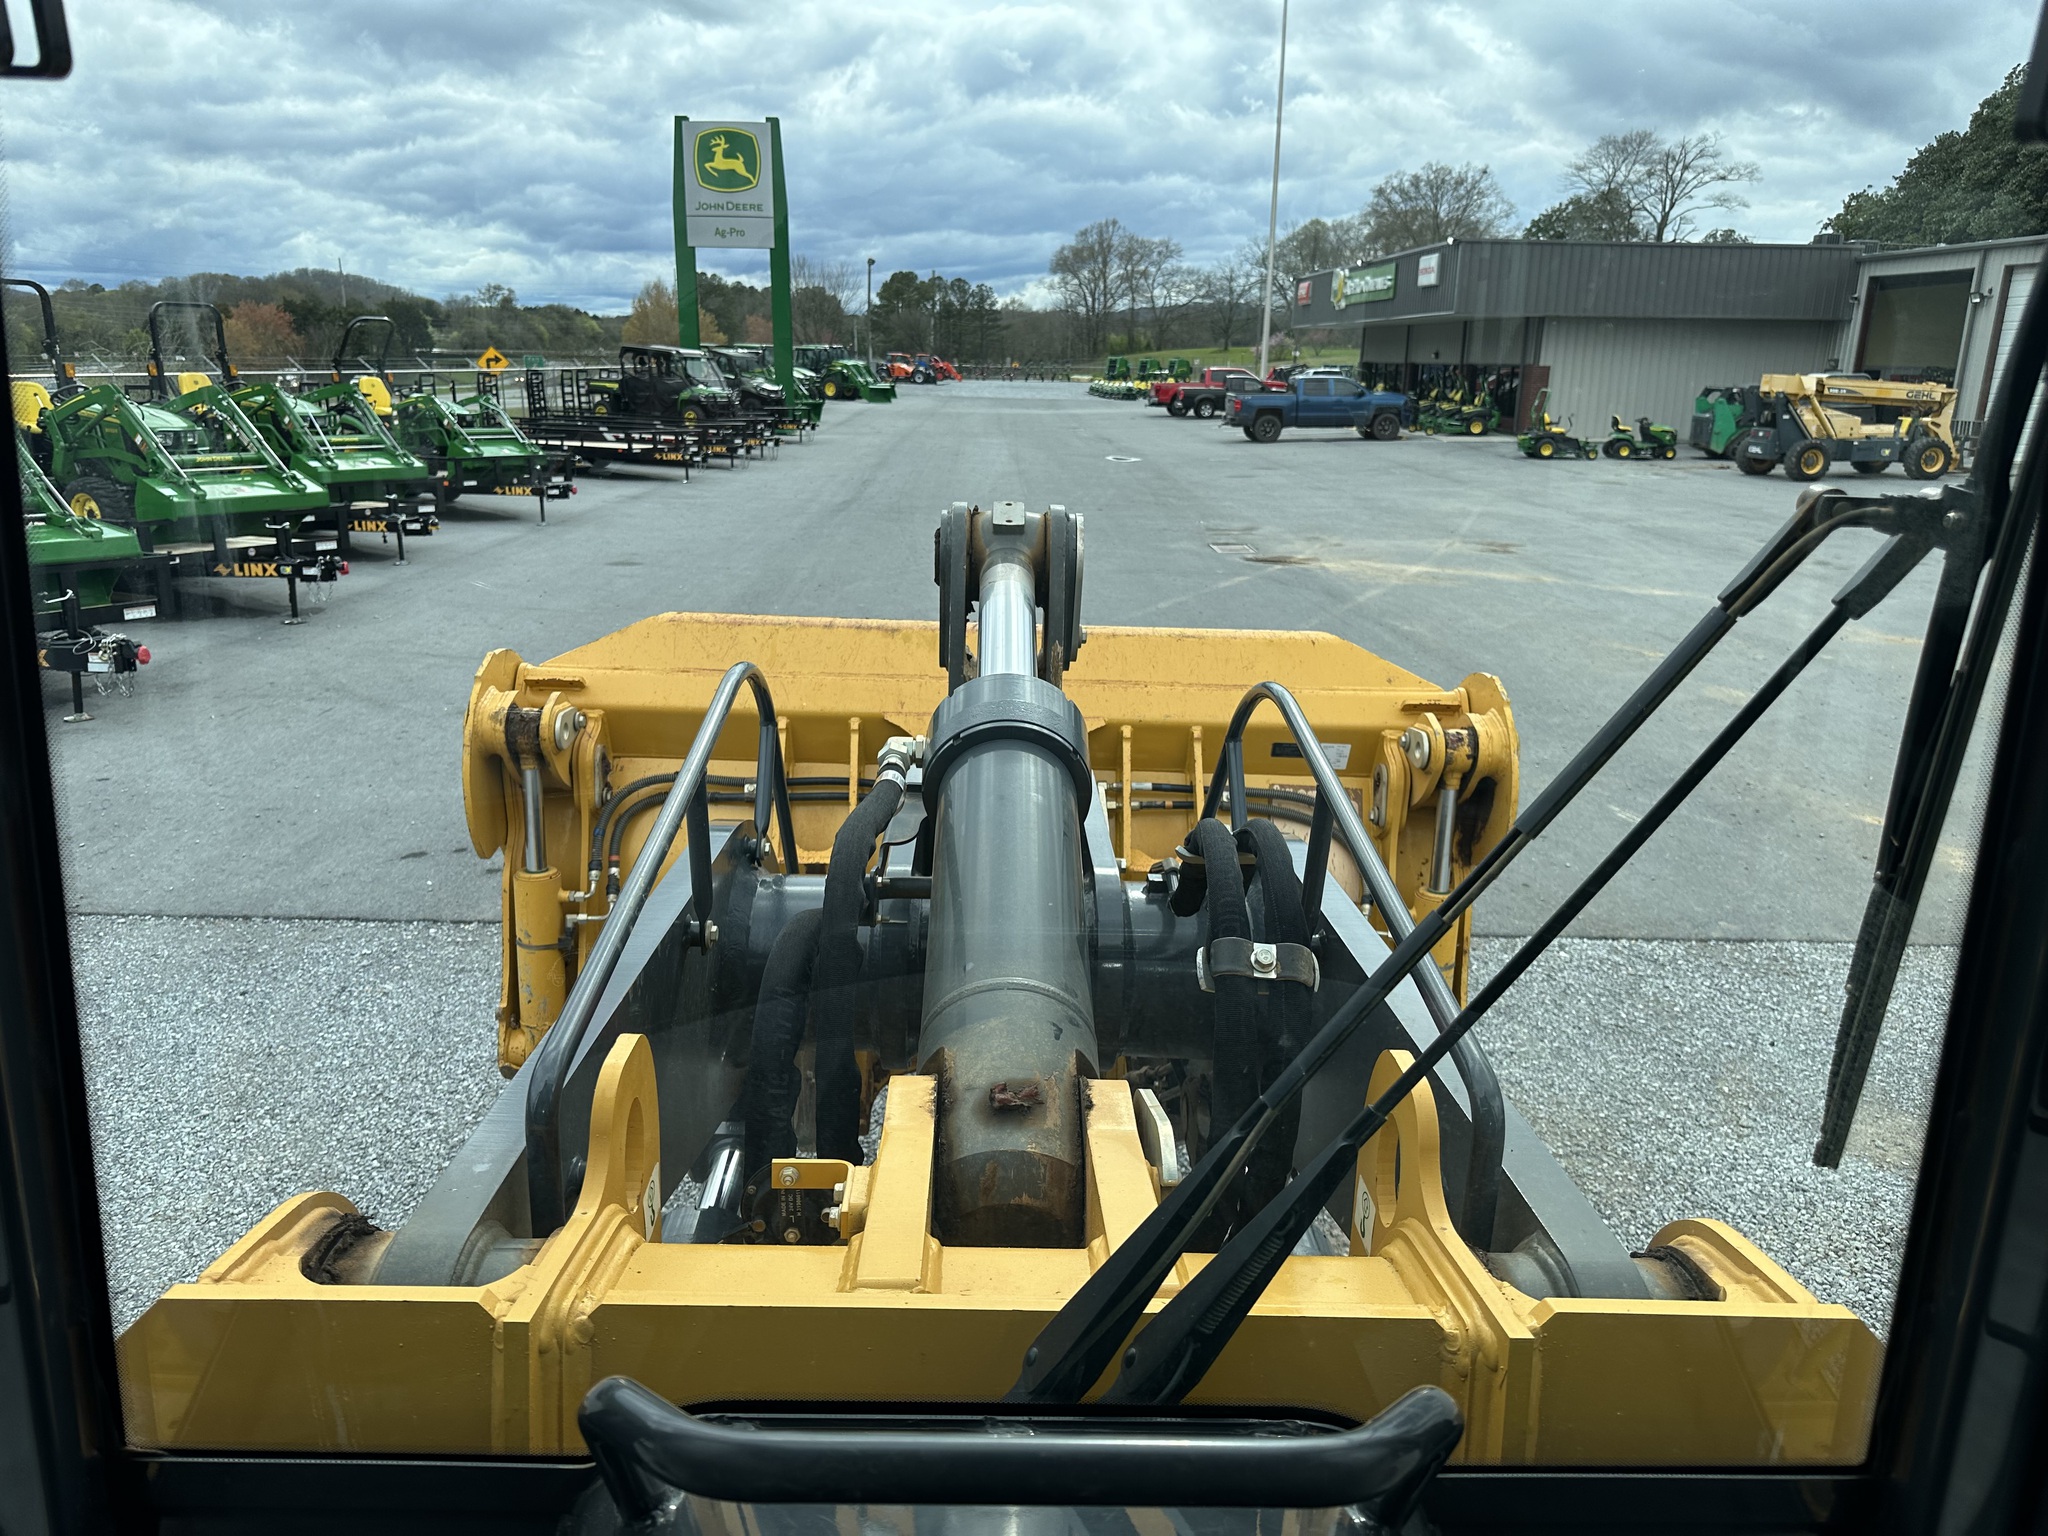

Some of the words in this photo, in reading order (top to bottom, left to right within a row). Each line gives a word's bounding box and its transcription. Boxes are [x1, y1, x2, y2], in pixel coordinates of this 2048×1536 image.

[695, 201, 724, 211] JOHN
[726, 201, 764, 212] DEERE
[714, 227, 746, 239] Ag-Pro
[1906, 390, 1936, 400] GEHL
[662, 453, 683, 461] LINX
[505, 486, 532, 496] LINX
[353, 520, 388, 532] LINX
[233, 563, 279, 577] LINX
